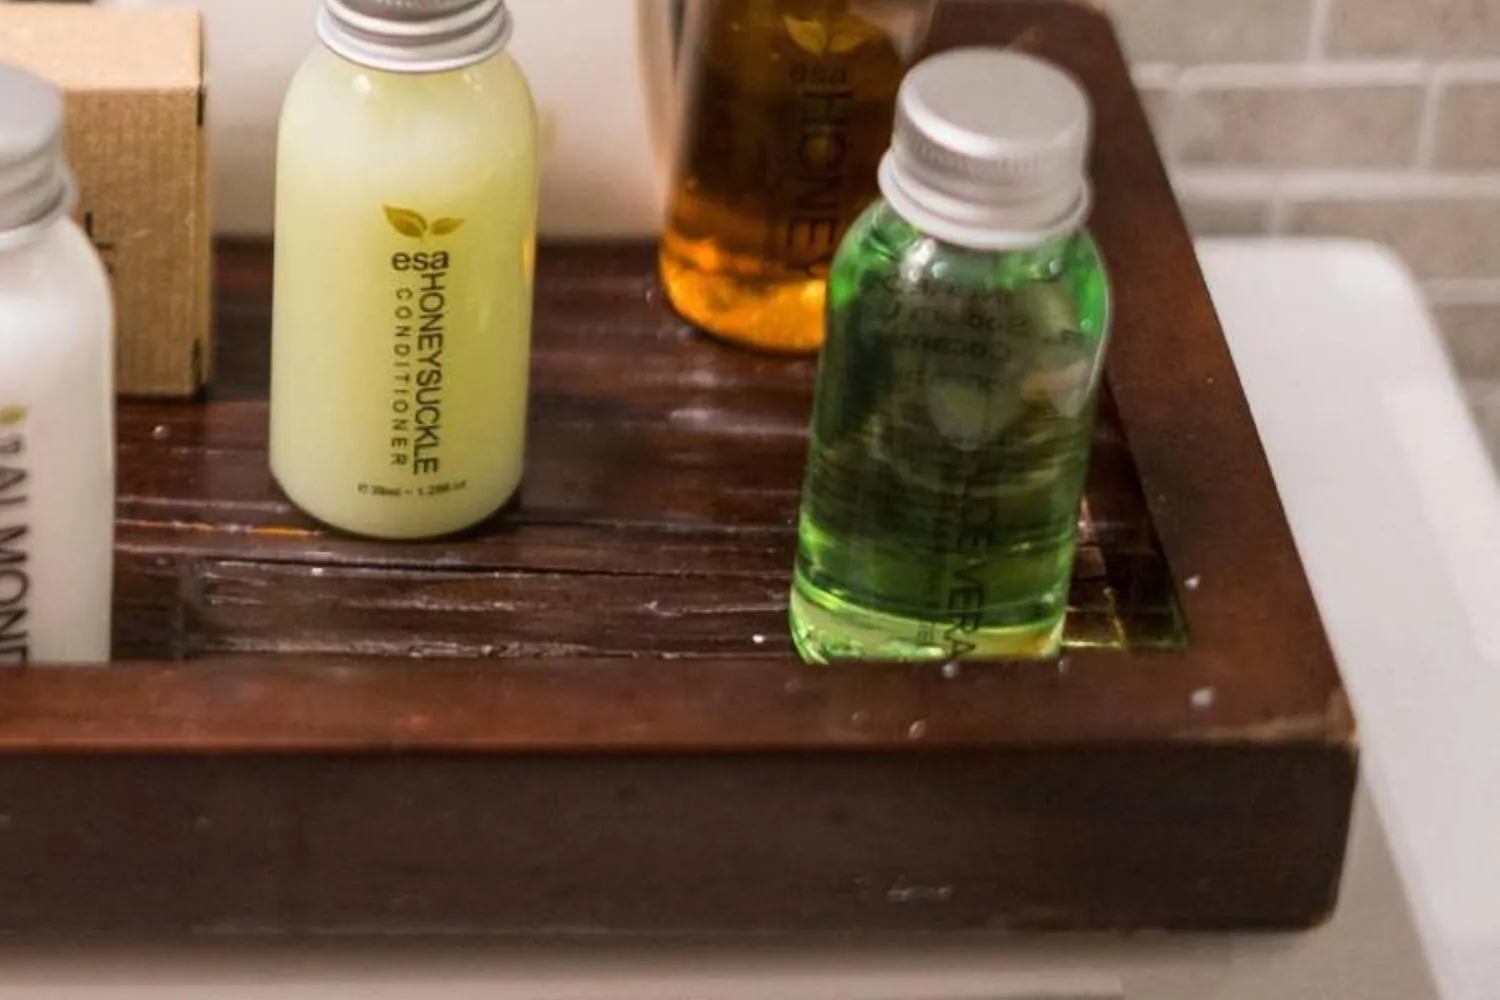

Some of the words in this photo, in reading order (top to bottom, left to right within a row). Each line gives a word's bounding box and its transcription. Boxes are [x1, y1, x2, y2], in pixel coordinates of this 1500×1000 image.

[392, 250, 449, 272] esa
[390, 287, 413, 467] CONDITIONER
[413, 272, 445, 475] HONEYSUCKLE
